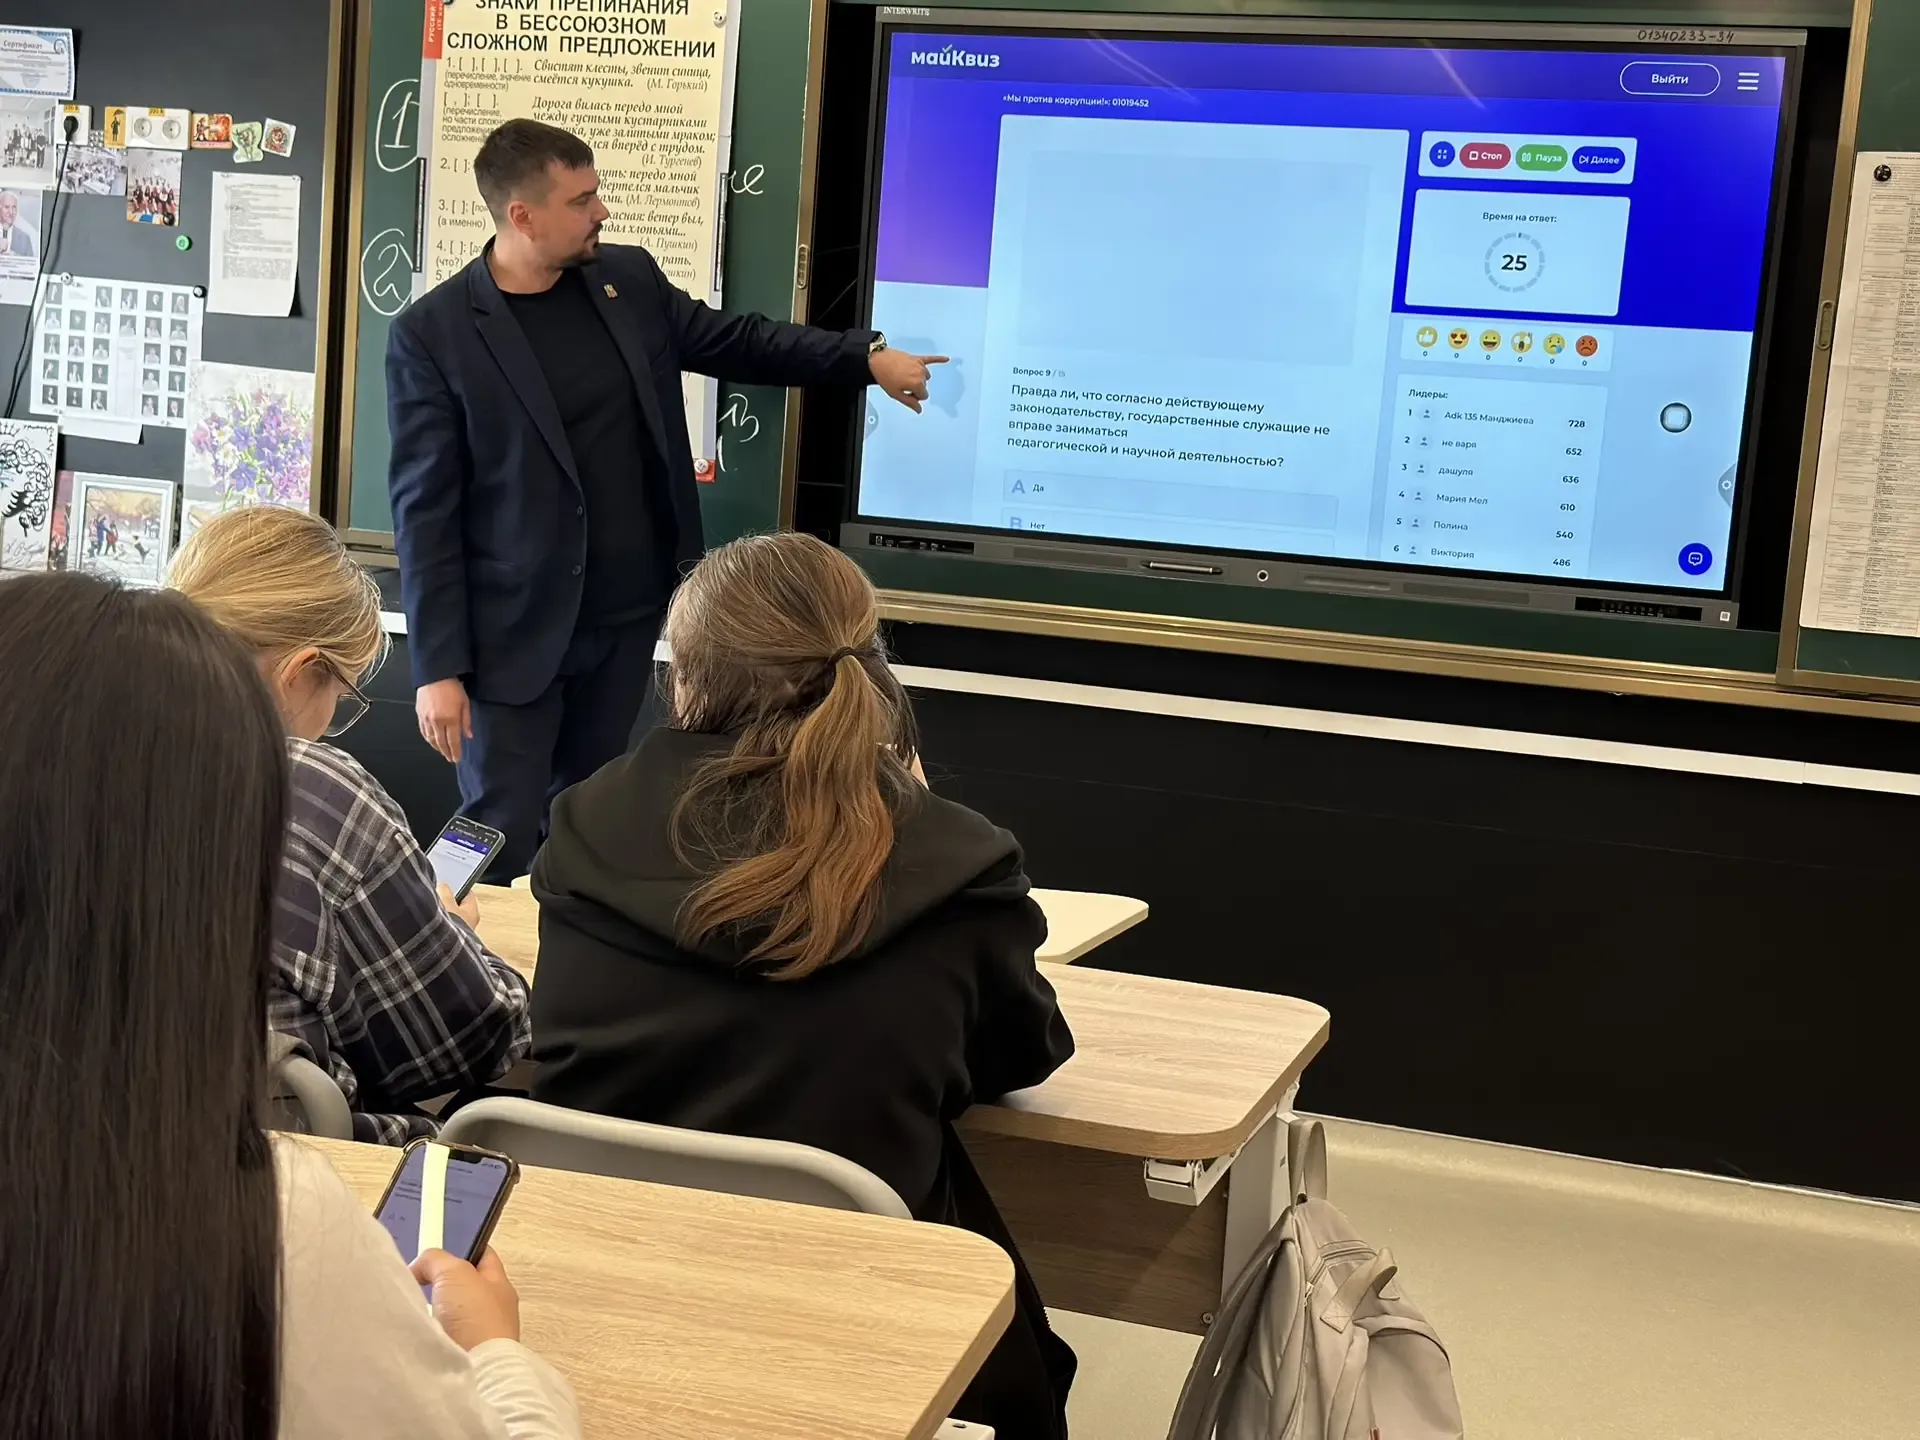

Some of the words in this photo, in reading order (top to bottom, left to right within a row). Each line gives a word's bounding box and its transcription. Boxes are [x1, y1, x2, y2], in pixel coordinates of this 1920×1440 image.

[883, 6, 930, 16] INTERWRITE
[427, 6, 437, 43] РУССКИЙ
[496, 13, 508, 30] В
[520, 14, 666, 35] БЕССОЮЗНОМ
[447, 32, 547, 52] СЛОЖНОМ
[560, 36, 715, 58] ПРЕДЛОЖЕНИИ
[534, 59, 583, 73] Свистят
[585, 63, 629, 76] клесты,
[630, 63, 670, 77] звенит
[672, 67, 711, 80] синица,
[533, 73, 579, 86] смеётся
[581, 76, 634, 90] кукушка.
[666, 79, 708, 93] Горький)
[1651, 73, 1689, 84] Выйти
[532, 96, 572, 110] Дорога
[575, 98, 612, 111] вилась
[614, 101, 651, 116] передо
[654, 103, 684, 115] мной
[1023, 95, 1053, 104] против
[1112, 98, 1149, 108] 01019452
[570, 114, 621, 126] густыми
[624, 116, 708, 130] кустарниками
[589, 127, 611, 141] уже
[612, 128, 669, 140] залитыми
[671, 131, 716, 144] мраком;
[611, 138, 648, 154] вперёд
[650, 143, 656, 151] с
[658, 143, 705, 157] трудом.
[659, 154, 702, 169] Тургенев)
[1481, 151, 1502, 161] Стоп
[1535, 153, 1562, 164] Пауза
[1590, 155, 1620, 165] Далее
[629, 168, 666, 182] передо
[668, 171, 697, 182] мной
[653, 184, 700, 195] мальчик
[644, 195, 700, 209] Лермонтов)
[449, 217, 486, 231] именно)
[647, 211, 679, 226] ветер
[681, 212, 704, 226] выл,
[1482, 212, 1513, 222] Время
[1515, 213, 1527, 222] на
[1529, 214, 1557, 223] ответ:
[628, 225, 686, 237] хлопьями...
[656, 238, 698, 252] Пушкин)
[661, 256, 691, 268] рать.
[1501, 254, 1528, 272] 25
[1012, 367, 1044, 377] Вопрос
[1045, 369, 1051, 377] 9
[1011, 384, 1057, 398] Правда
[1060, 390, 1079, 401] ли,
[1082, 391, 1103, 401] что
[1105, 393, 1163, 406] согласно
[1165, 397, 1265, 414] действующему
[1408, 389, 1448, 400] Лидеры:
[1009, 403, 1124, 422] законодательству,
[1127, 411, 1240, 429] государственные
[1242, 420, 1311, 435] служащие
[1314, 425, 1330, 436] не
[1444, 411, 1463, 421] Adk
[1464, 412, 1478, 422] 135
[1479, 414, 1534, 425] Манджиева
[1568, 419, 1586, 428] 728
[1008, 420, 1052, 432] вправе
[1056, 424, 1128, 438] заниматься
[1007, 437, 1107, 454] педагогической
[1110, 446, 1119, 454] и
[1122, 446, 1175, 459] научной
[1178, 450, 1284, 468] деятельностью?
[1404, 436, 1410, 444] 2
[1455, 441, 1477, 450] варя
[1565, 447, 1582, 456] 652
[1401, 463, 1407, 471] 3
[1438, 467, 1473, 477] дашуля
[1562, 475, 1579, 484] 636
[1032, 483, 1044, 493] Да
[1398, 490, 1405, 498] 4
[1436, 493, 1467, 504] Мария
[1560, 503, 1576, 512] 610
[1030, 521, 1046, 530] Нет
[1433, 520, 1469, 531] Полина
[1555, 530, 1574, 539] 540
[1430, 548, 1475, 560] Виктория
[1552, 558, 1571, 567] 486
